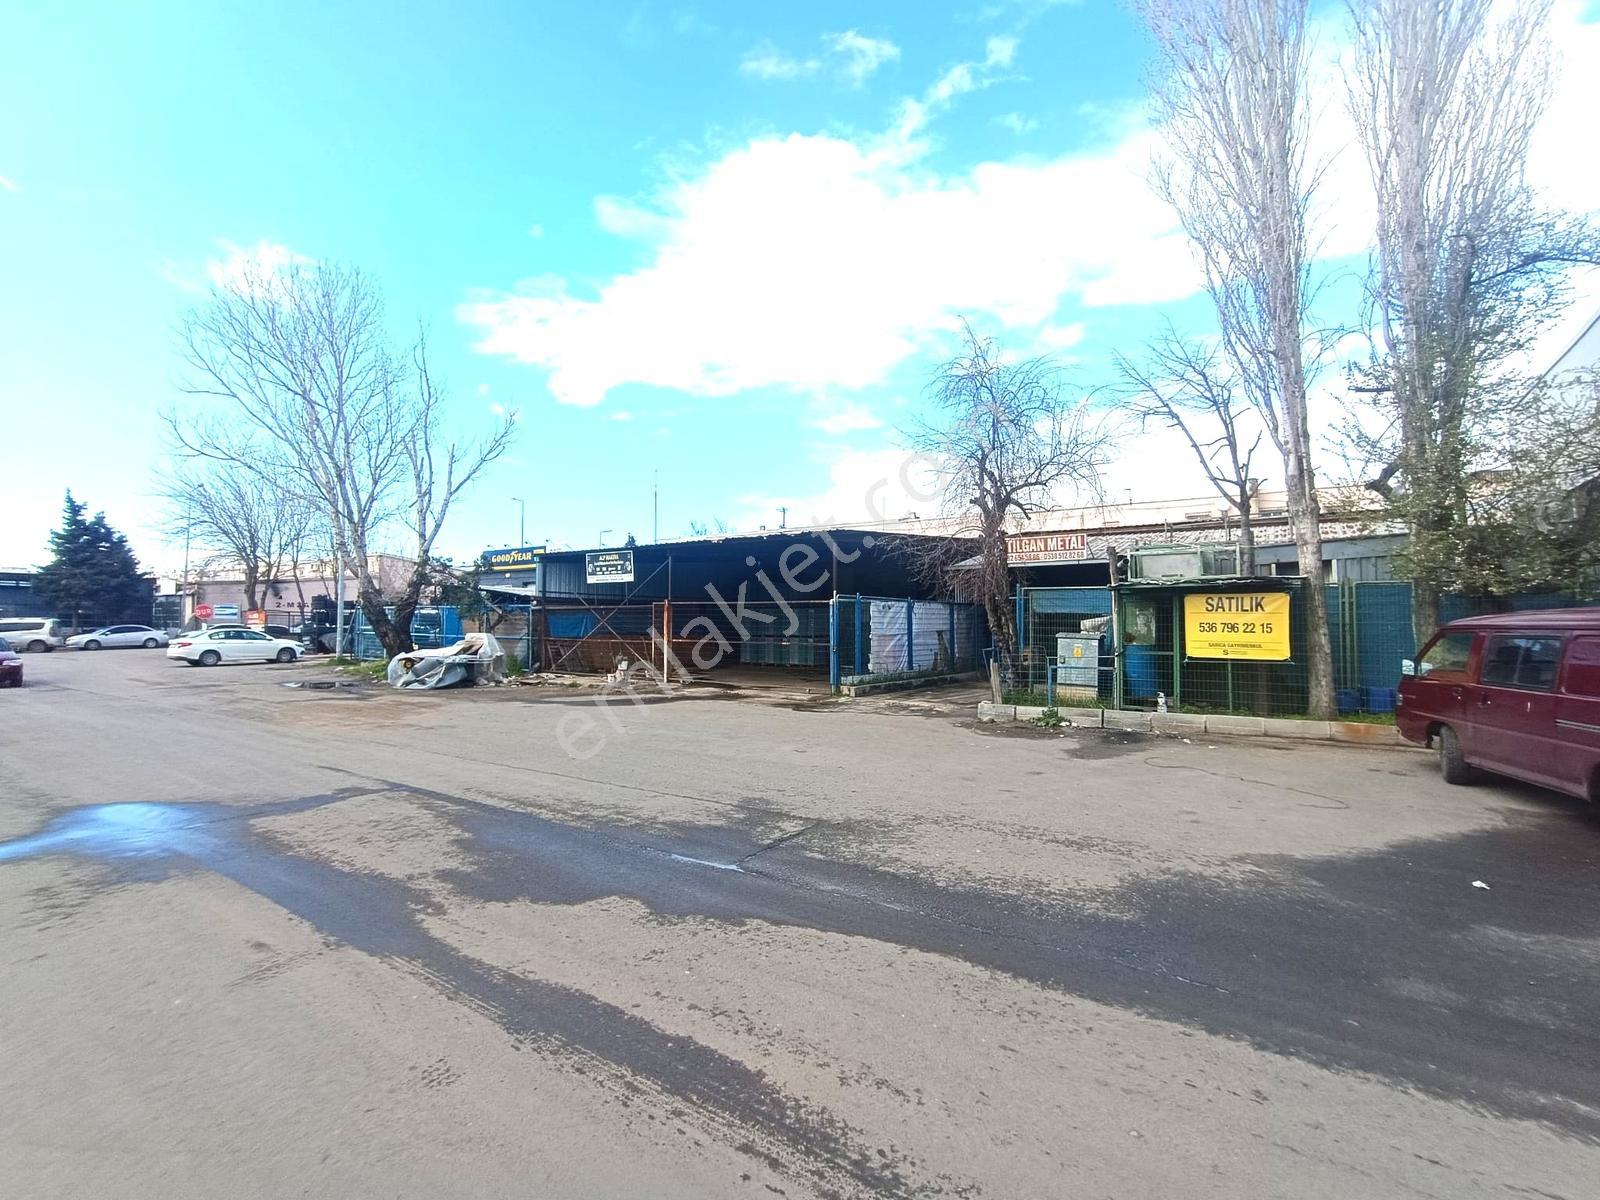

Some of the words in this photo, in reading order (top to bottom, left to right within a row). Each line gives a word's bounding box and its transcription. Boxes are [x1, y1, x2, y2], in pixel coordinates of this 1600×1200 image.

[1006, 539, 1045, 553] TILGAN
[1047, 536, 1085, 551] METAL
[492, 551, 532, 564] GOODYEAR
[1205, 596, 1266, 612] SATILIK
[1199, 622, 1218, 633] 536
[1220, 622, 1240, 633] 796
[1242, 622, 1256, 634] 22
[1260, 622, 1273, 634] 15
